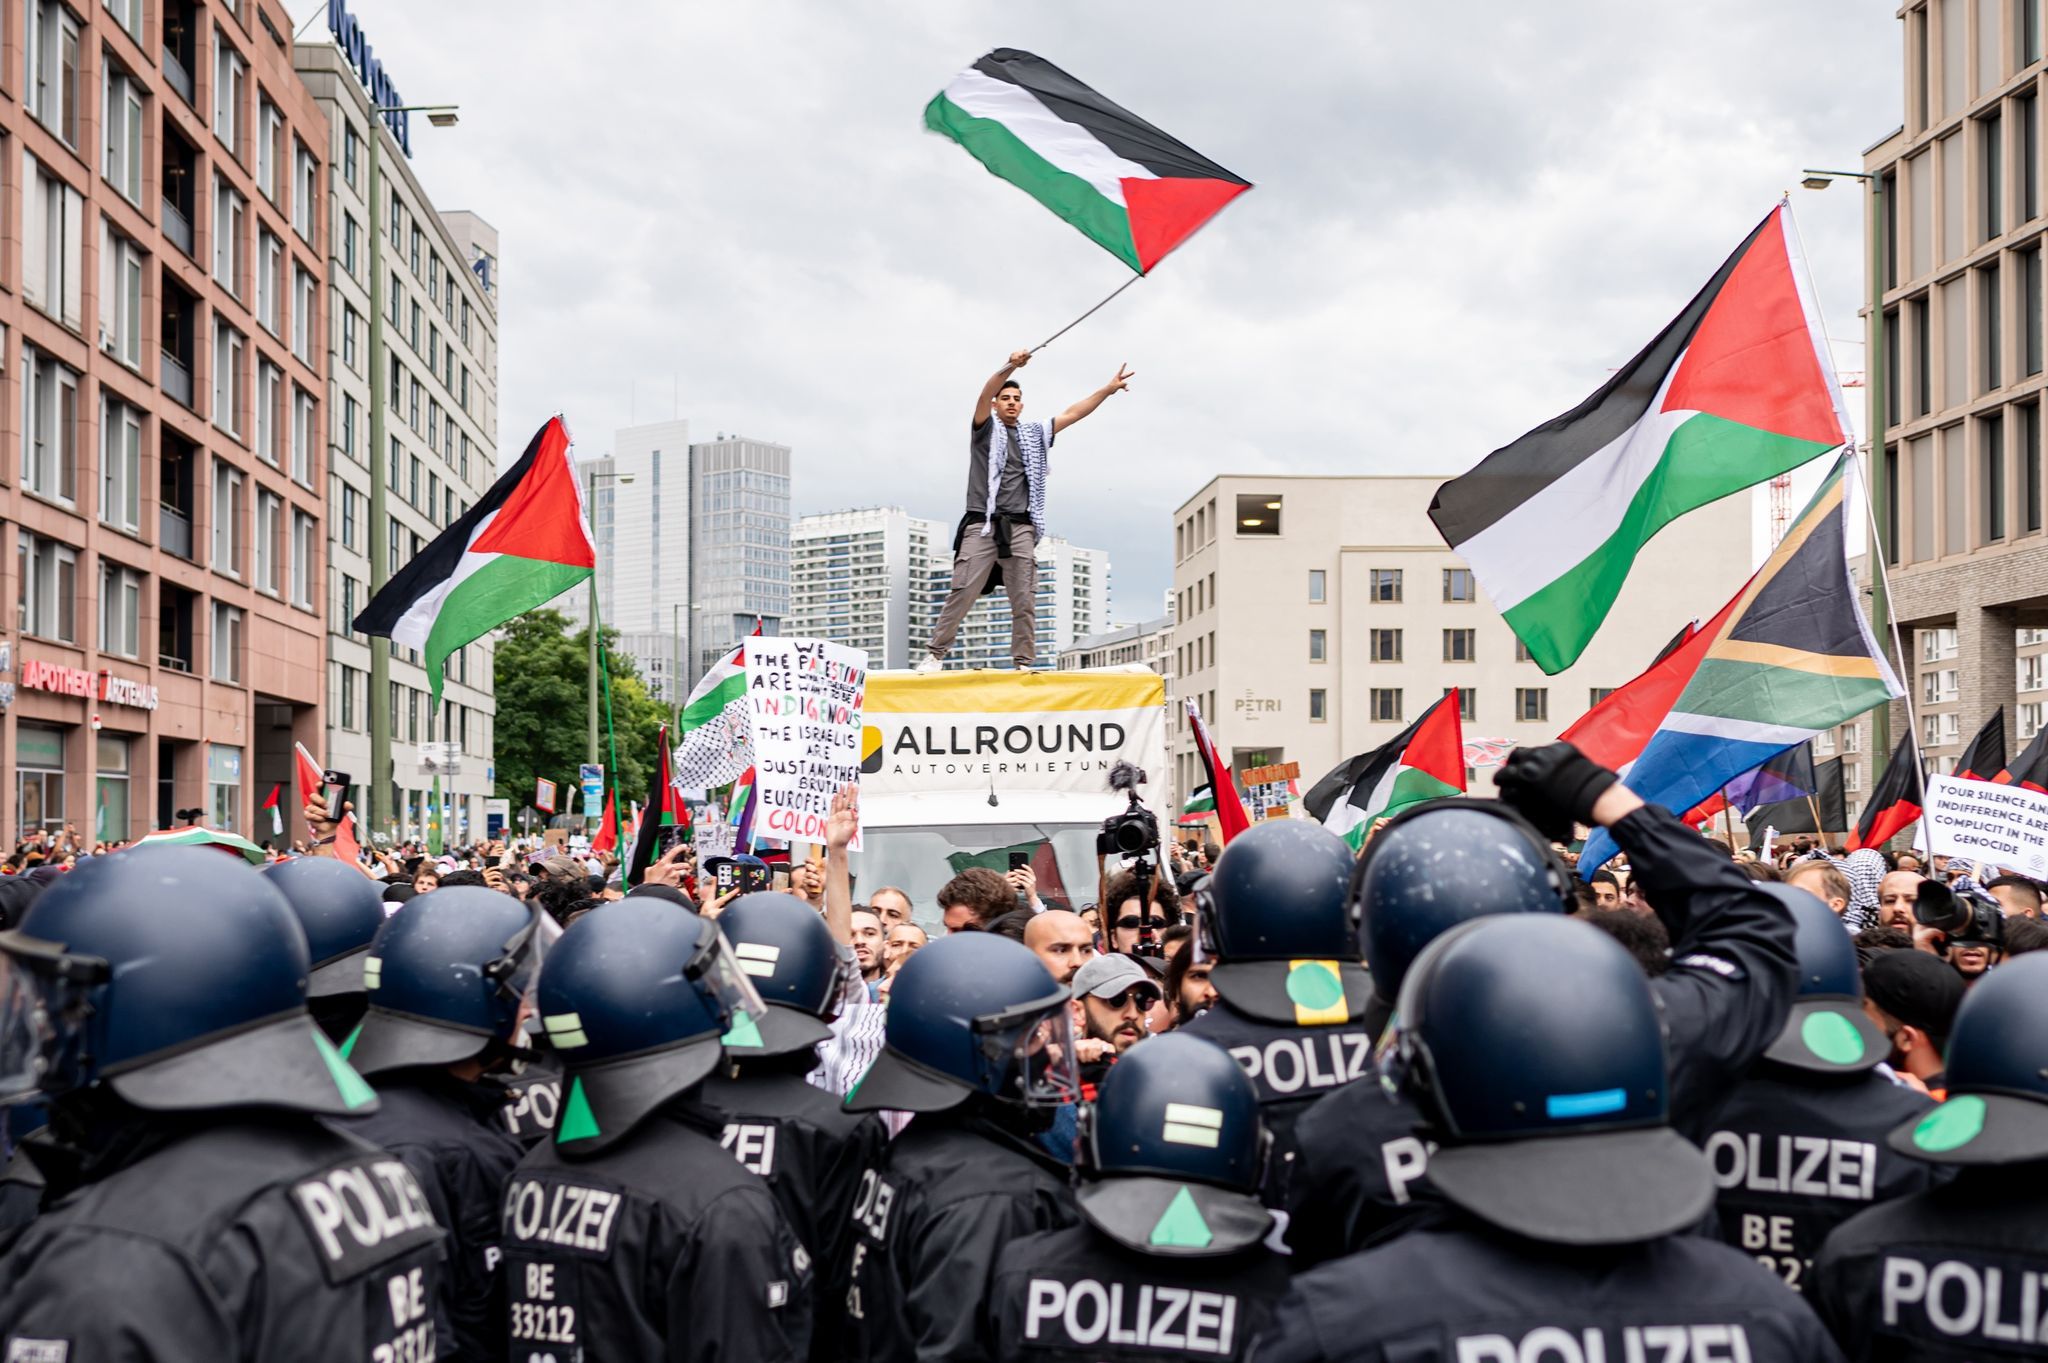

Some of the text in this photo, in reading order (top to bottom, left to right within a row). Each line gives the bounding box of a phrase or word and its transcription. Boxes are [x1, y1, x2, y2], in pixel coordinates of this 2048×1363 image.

[755, 654, 790, 669] THE
[794, 642, 824, 659] WE
[24, 660, 98, 699] APOTHEKE
[752, 672, 792, 690] ARE
[755, 695, 861, 730] INDIGENOUS
[1235, 699, 1281, 711] PETRI
[760, 726, 856, 749] THE ISRAELIS
[806, 744, 830, 760] ARE
[893, 722, 1125, 755] ALLROUND
[763, 760, 860, 784] JUST ANOTHER
[893, 760, 1108, 774] AUTOVERMIETUN
[798, 777, 839, 794] BRUTA
[1939, 784, 2048, 816] YOUR SILENCE AN
[763, 789, 828, 814] EUROPEA
[1937, 799, 2048, 831] INDIFFERENCE ARE
[1935, 815, 2045, 846] COMPLICIT IN THE
[1953, 834, 2019, 855] GENOCIDE
[1228, 1033, 1370, 1093] POLIZ
[1705, 1130, 1876, 1200] OLIZEI
[1742, 1213, 1794, 1252] BE
[526, 1262, 555, 1300] BE
[388, 1267, 426, 1328] BE
[511, 1302, 576, 1343] 33212
[1025, 1279, 1237, 1354] POLIZEI
